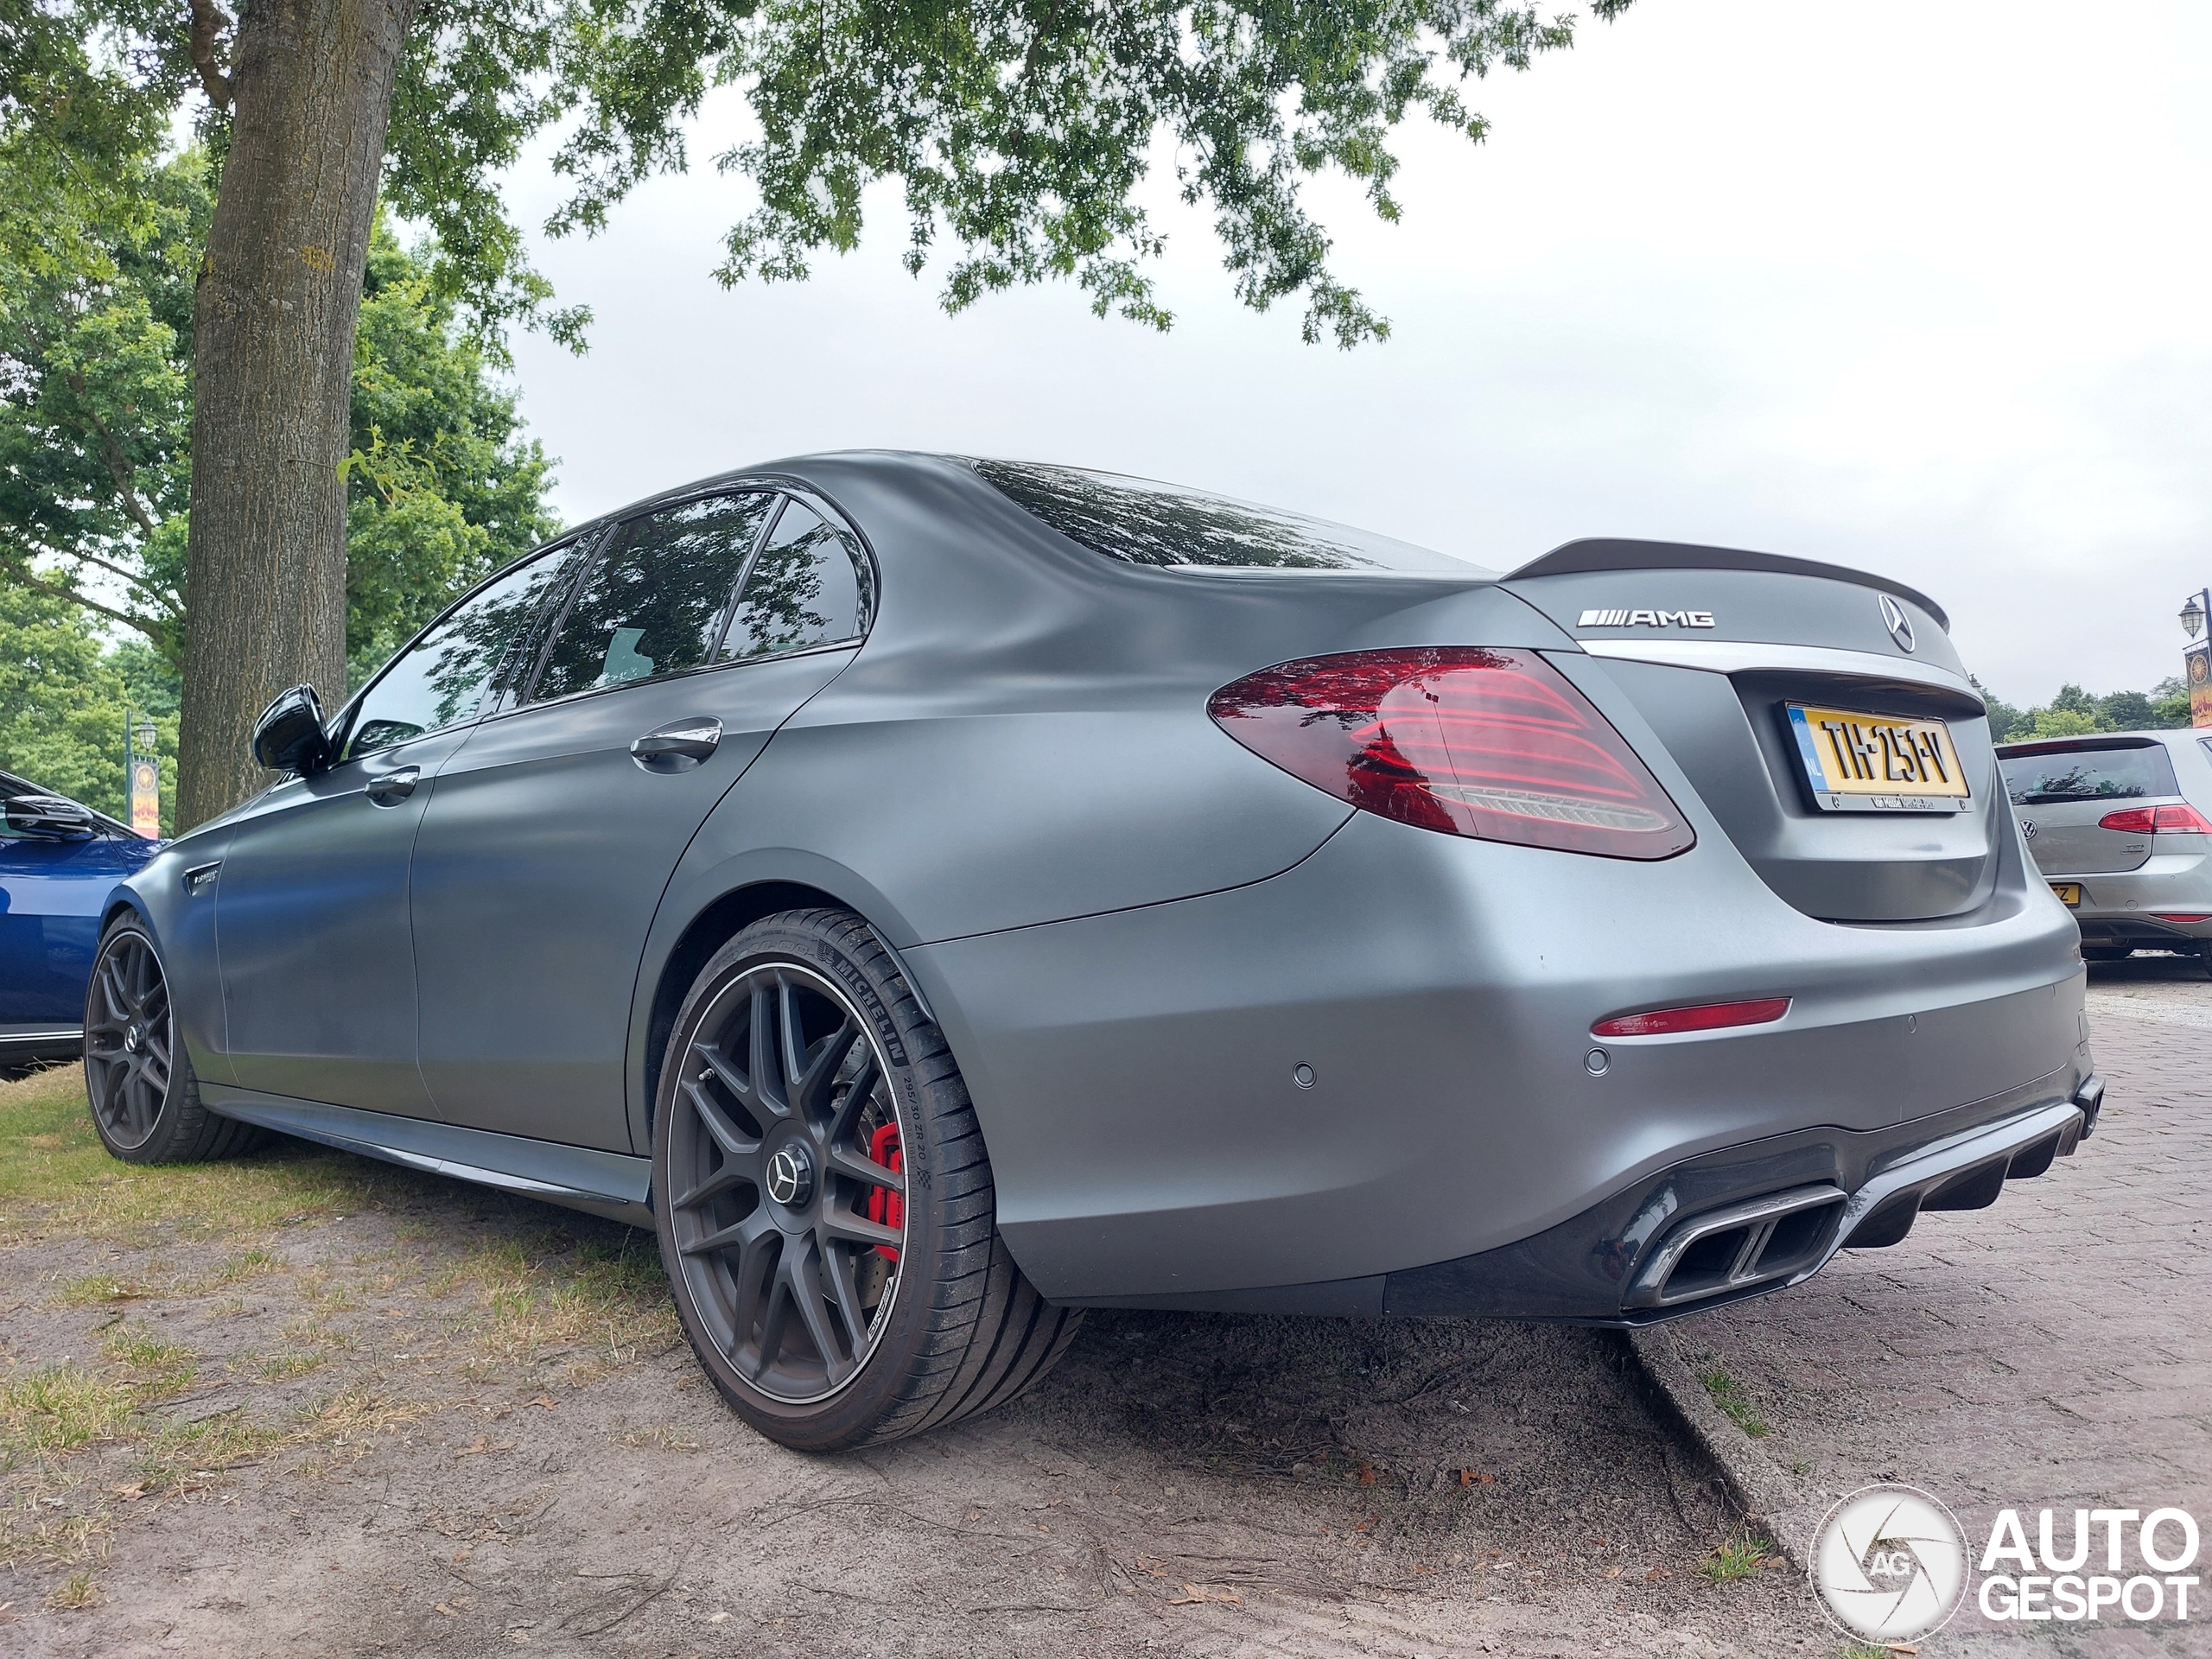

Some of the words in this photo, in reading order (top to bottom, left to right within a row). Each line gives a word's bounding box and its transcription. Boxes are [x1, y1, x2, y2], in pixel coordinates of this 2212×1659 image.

[1624, 609, 1716, 629] AMG
[1818, 720, 1950, 784] TH-251-V
[1805, 758, 1822, 777] NL
[836, 959, 904, 1059] MICHELIN
[903, 1077, 920, 1121] 295/30
[914, 1123, 924, 1141] ZR
[918, 1144, 926, 1160] 20
[868, 1299, 886, 1337] AMG
